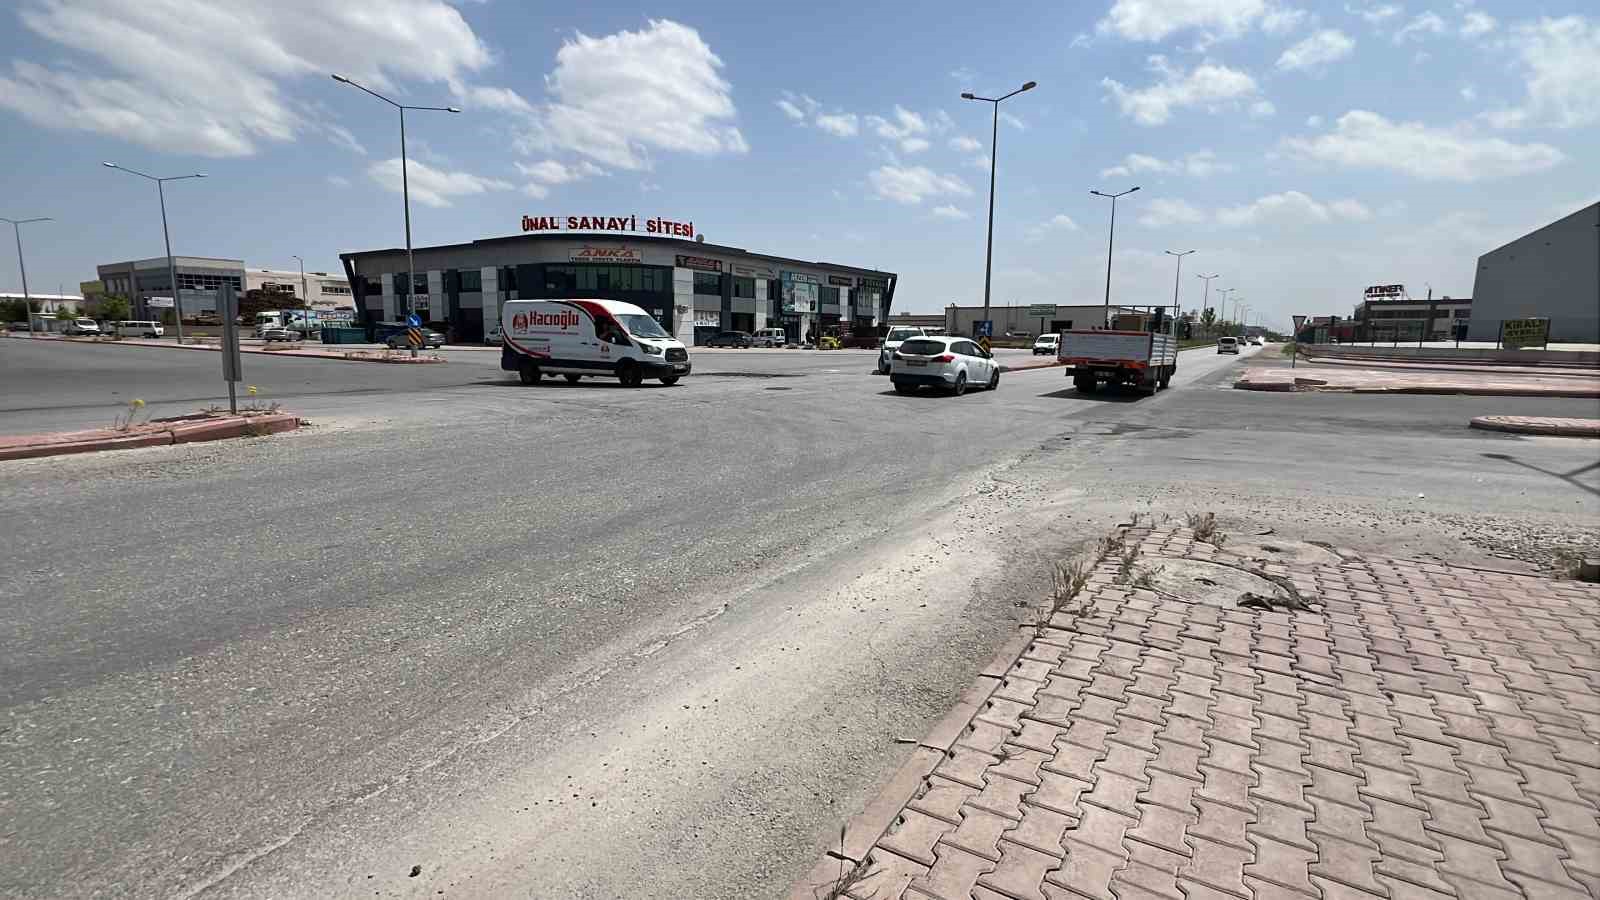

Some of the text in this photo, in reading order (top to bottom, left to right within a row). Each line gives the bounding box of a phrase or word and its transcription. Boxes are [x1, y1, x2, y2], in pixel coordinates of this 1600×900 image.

[522, 214, 694, 238] ÜNAL SANAYİ SİTESİ
[529, 310, 579, 330] Hacıoğlu
